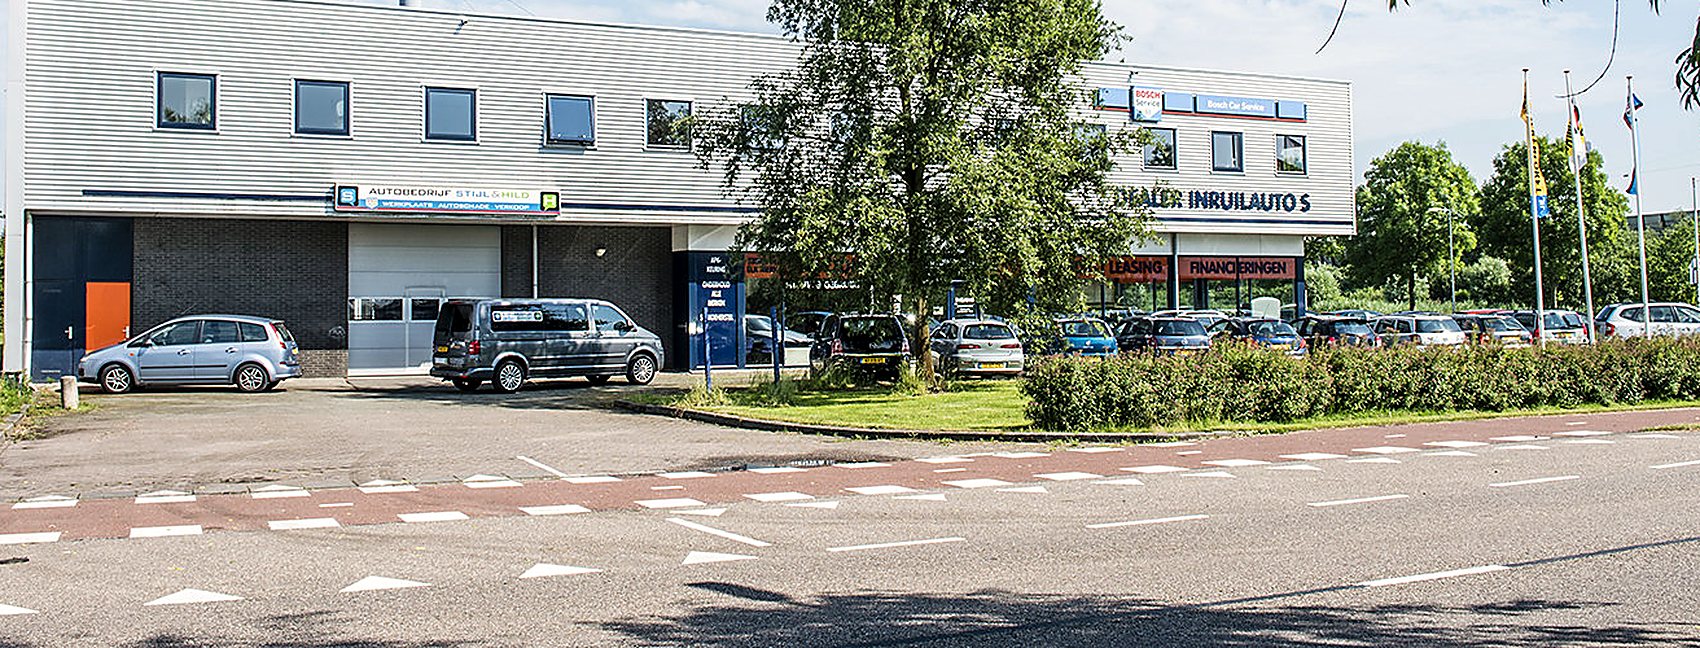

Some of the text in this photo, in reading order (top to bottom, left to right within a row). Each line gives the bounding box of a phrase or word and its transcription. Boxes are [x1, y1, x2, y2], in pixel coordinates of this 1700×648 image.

[1136, 90, 1160, 98] BOSCH
[1136, 99, 1160, 107] Service
[1207, 100, 1265, 111] Bosch Car Service
[369, 188, 451, 197] AUTOBEDRIJF
[1109, 260, 1162, 274] LEASING
[1190, 260, 1287, 274] FINANCIERINGEN
